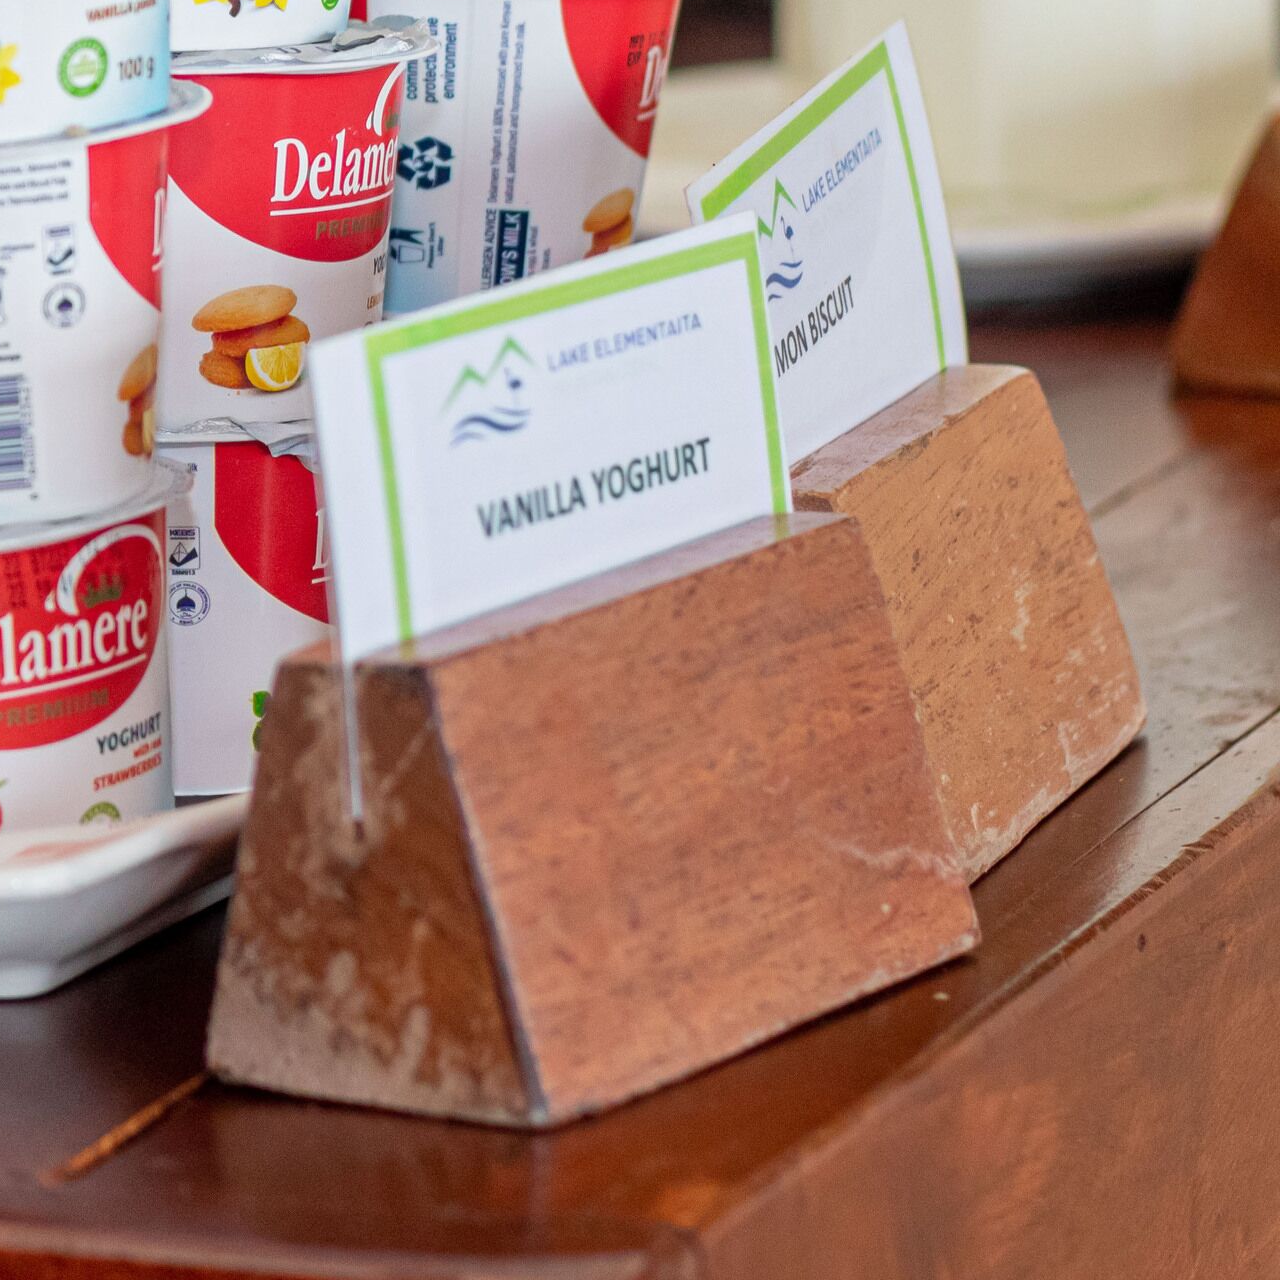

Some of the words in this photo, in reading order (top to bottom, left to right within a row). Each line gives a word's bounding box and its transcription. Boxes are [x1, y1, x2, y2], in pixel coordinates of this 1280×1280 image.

[443, 22, 458, 100] environment
[802, 177, 826, 213] LAKE
[825, 128, 883, 192] ELEMENTAITA
[485, 208, 497, 244] ADVICE
[503, 213, 521, 247] MILK
[547, 342, 590, 373] LAKE
[593, 313, 702, 359] ELEMENTAITA
[774, 320, 809, 378] MON
[808, 275, 855, 346] BISCUIT
[477, 476, 587, 538] VANILLA
[591, 437, 711, 504] YOGHURT
[96, 711, 161, 754] YOGHURT
